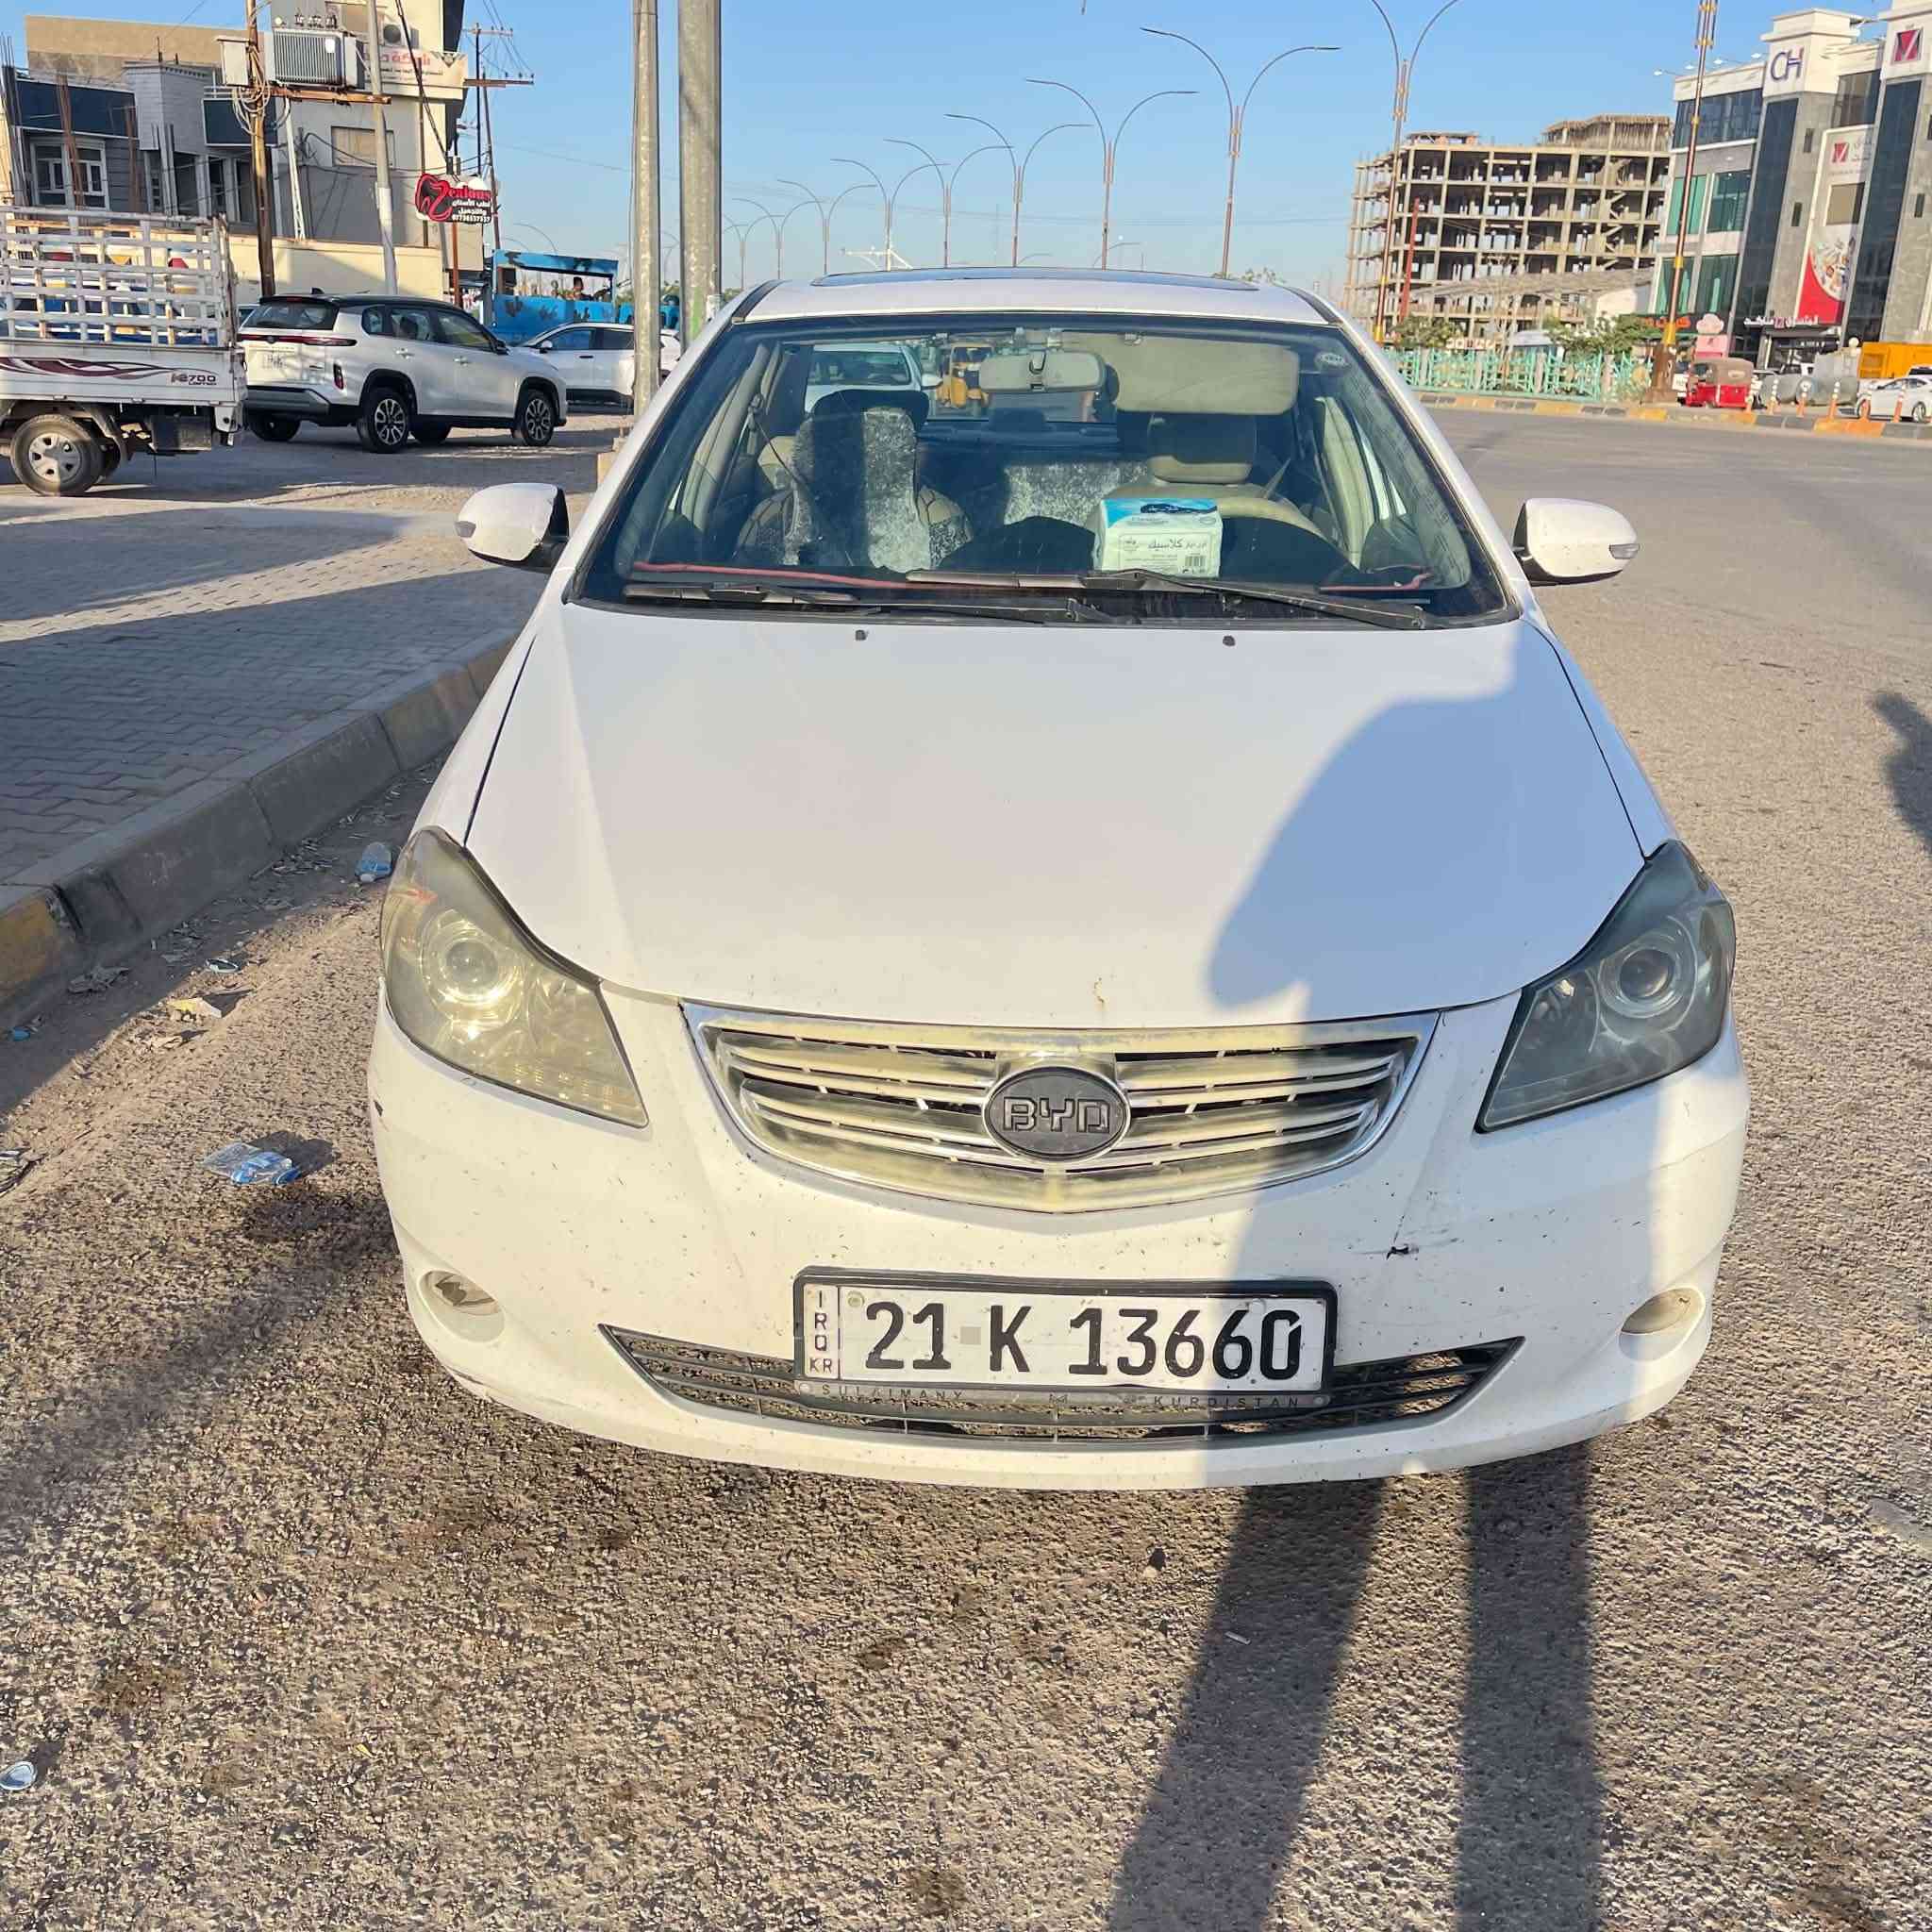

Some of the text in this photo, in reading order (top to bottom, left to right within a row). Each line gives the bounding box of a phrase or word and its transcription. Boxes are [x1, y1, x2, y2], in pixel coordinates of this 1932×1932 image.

[1770, 47, 1805, 81] CH
[1004, 1096, 1110, 1133] BYD
[865, 1300, 1302, 1380] 21 K 13660
[822, 1385, 964, 1400] SULAIMANY
[1154, 1395, 1299, 1407] KURDISTAN
